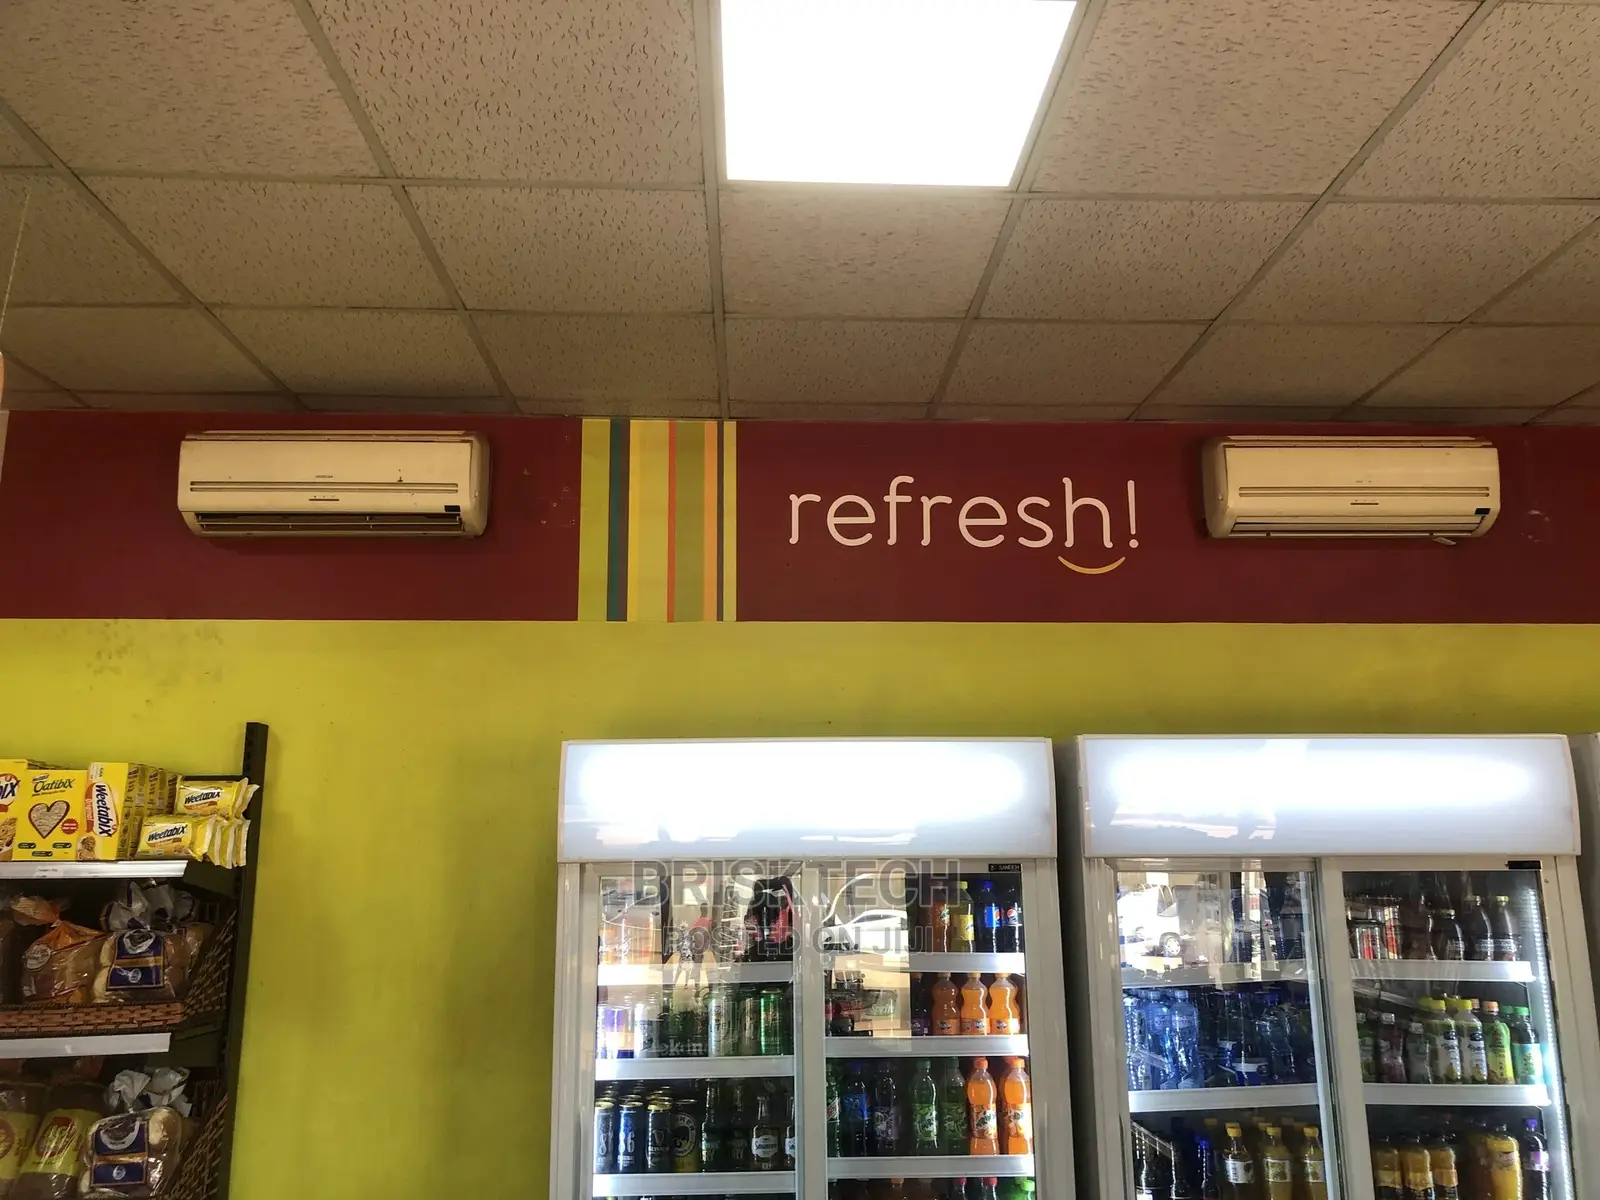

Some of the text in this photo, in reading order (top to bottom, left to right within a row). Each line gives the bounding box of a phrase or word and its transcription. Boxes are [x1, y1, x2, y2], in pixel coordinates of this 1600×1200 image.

[789, 475, 1139, 549] refresh!
[95, 785, 113, 837] Weetabix
[184, 790, 221, 804] Weetabix
[148, 824, 188, 841] Weetabix
